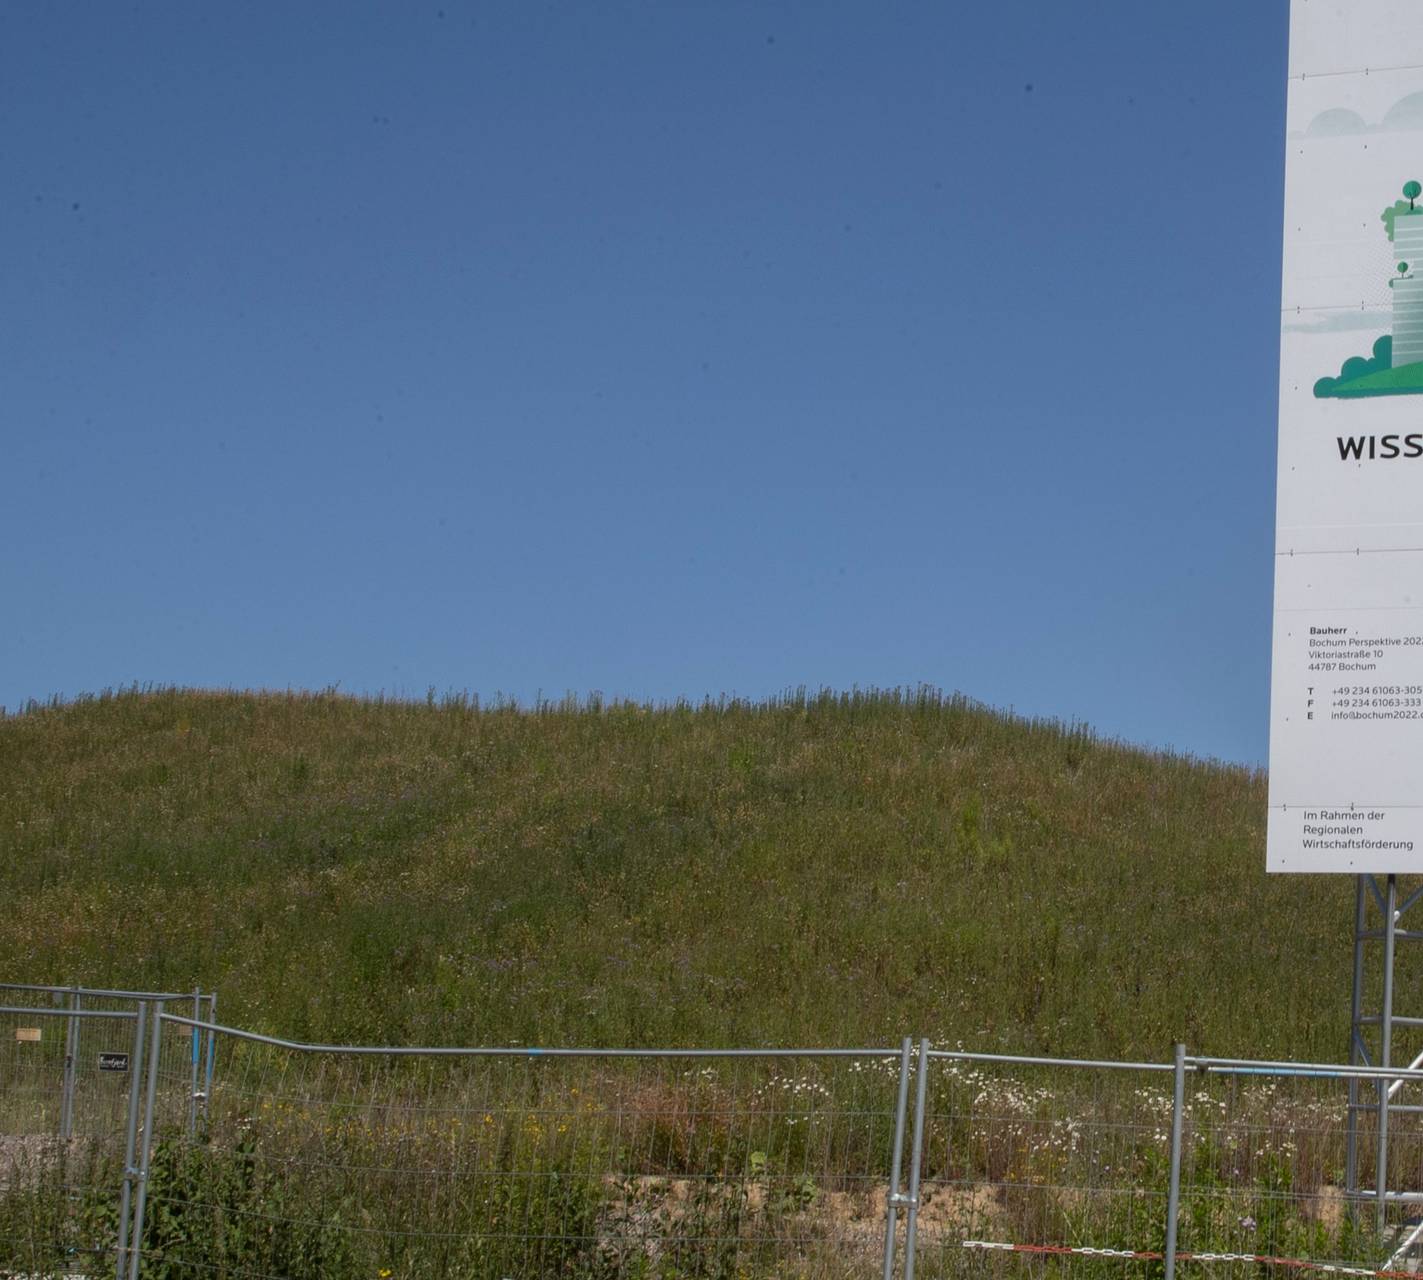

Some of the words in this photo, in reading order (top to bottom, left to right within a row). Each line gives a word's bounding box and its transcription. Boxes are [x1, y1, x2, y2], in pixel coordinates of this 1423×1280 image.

[1309, 626, 1347, 635] Bauherr
[1309, 639, 1347, 647] Bochum
[1349, 638, 1401, 648] Perspektive
[1308, 650, 1371, 660] Viktoriastraße
[1374, 650, 1384, 658] 10
[1308, 663, 1337, 672] 44787
[1338, 662, 1377, 671] Bochum
[1308, 687, 1314, 696] T
[1332, 687, 1350, 696] +49
[1352, 687, 1370, 695] 234
[1372, 686, 1423, 695] 61063-305
[1307, 699, 1314, 708] F
[1332, 699, 1350, 708] +49
[1352, 699, 1370, 707] 234
[1372, 698, 1422, 707] 61063-333
[1307, 711, 1314, 720] E
[1303, 811, 1318, 820] Im
[1320, 811, 1365, 820] Rahmen
[1367, 810, 1385, 820] der
[1303, 825, 1363, 836] Regionalen
[1303, 839, 1414, 851] Wirtschaftsförderung
